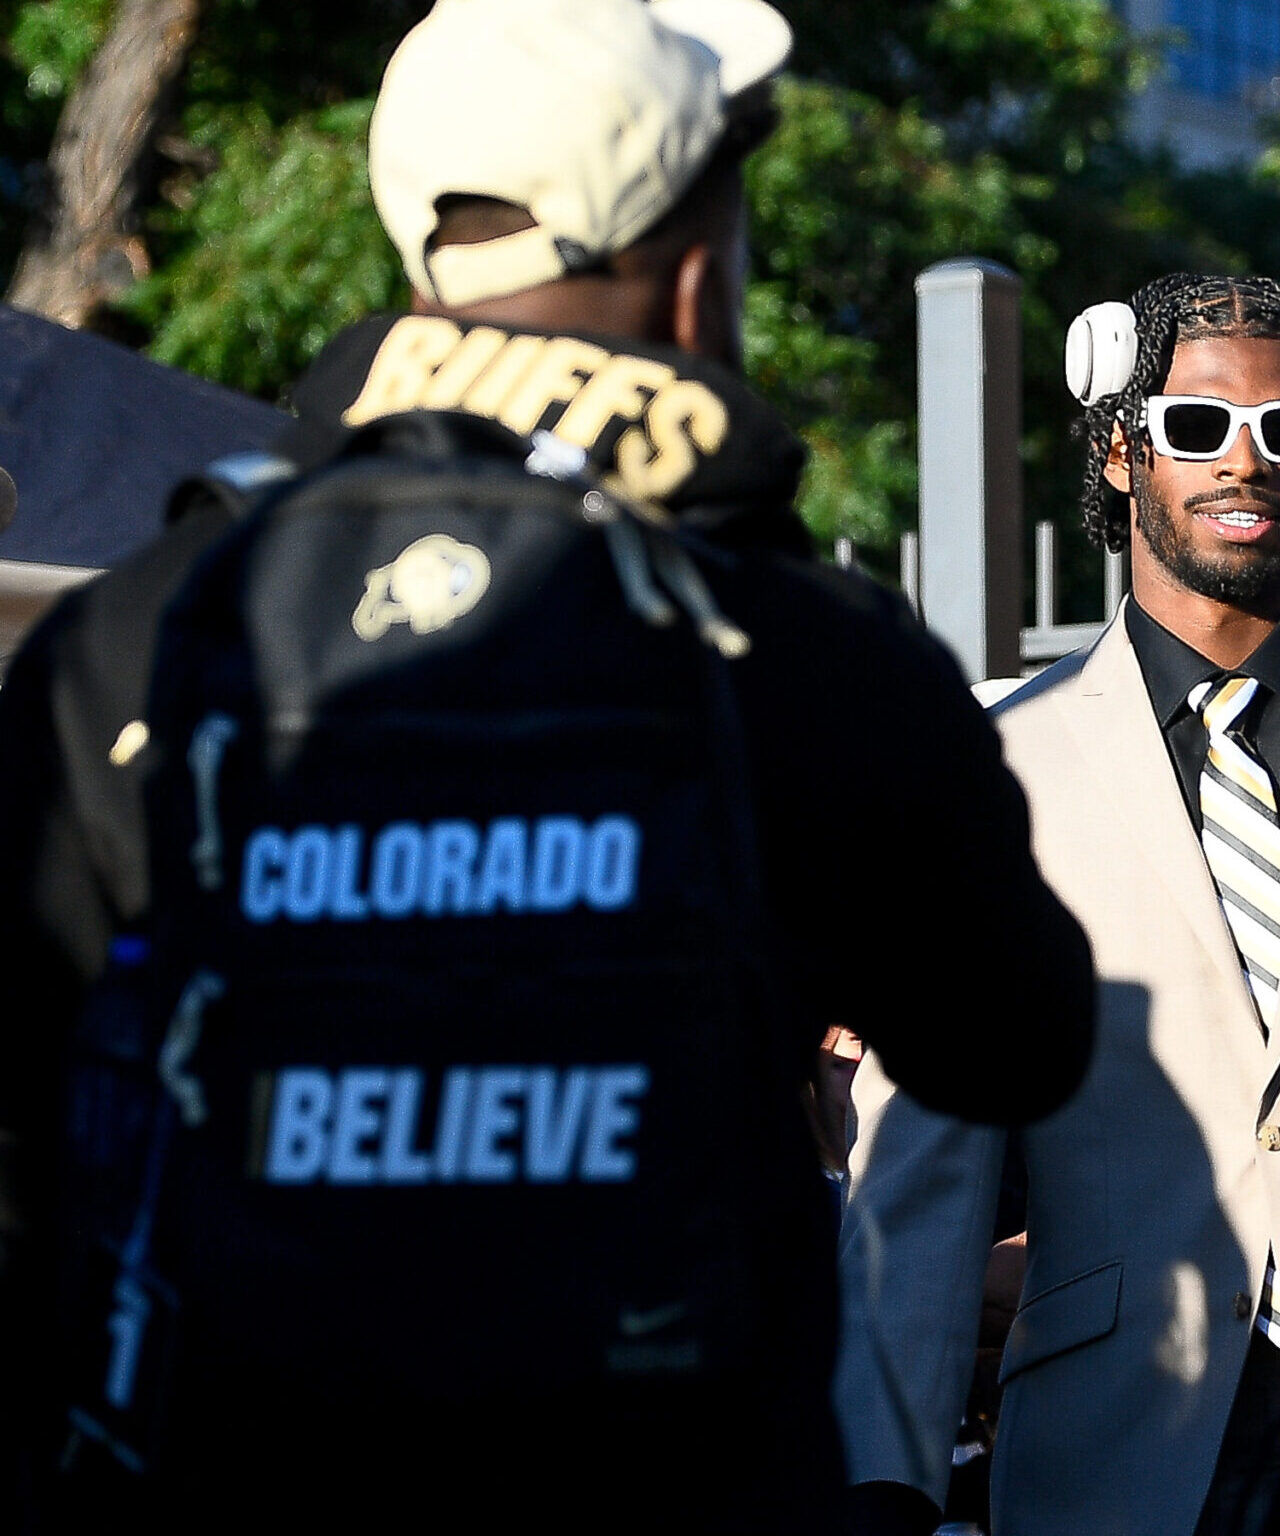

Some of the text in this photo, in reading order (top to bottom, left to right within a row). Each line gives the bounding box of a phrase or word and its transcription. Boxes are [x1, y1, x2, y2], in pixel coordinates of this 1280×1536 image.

[341, 315, 728, 499] BUFFS
[242, 815, 639, 921] COLORADO
[266, 1067, 647, 1183] BELIEVE
